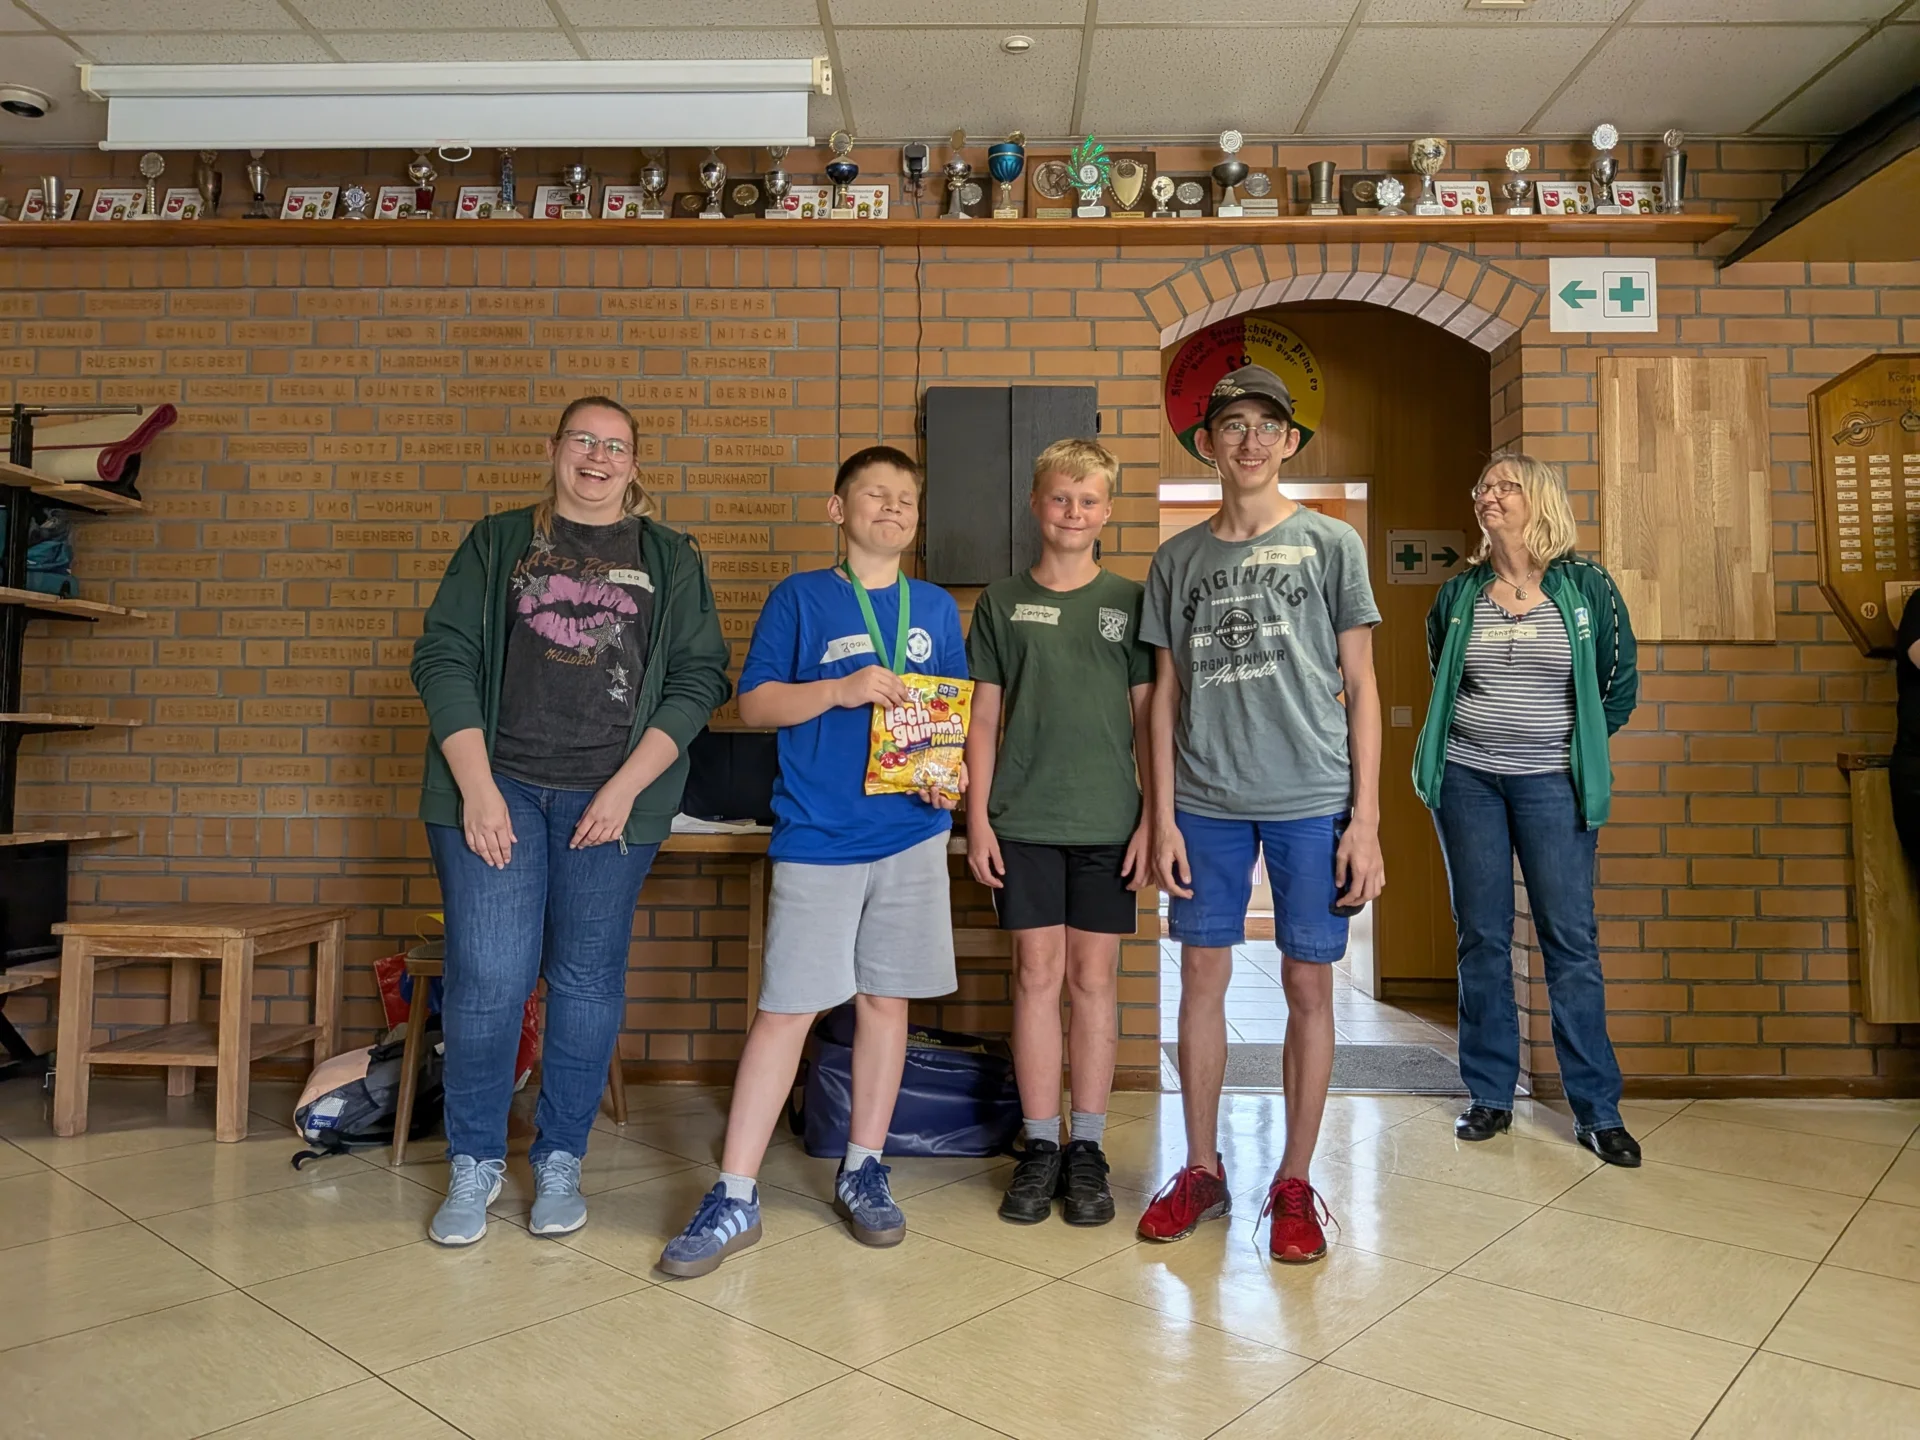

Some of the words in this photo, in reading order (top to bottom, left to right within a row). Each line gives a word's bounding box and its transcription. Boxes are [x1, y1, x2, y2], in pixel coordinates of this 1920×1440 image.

[1081, 187, 1102, 201] 2004
[716, 327, 787, 340] NITSCH
[449, 385, 528, 399] SCHIFFNER
[539, 385, 567, 398] EVA
[628, 383, 699, 399] JÜRGEN
[384, 413, 455, 426] K.PETERS
[715, 444, 785, 457] BARTHOLD
[350, 471, 406, 484] WIESE
[715, 503, 787, 516] D.PALANDT
[336, 529, 414, 543] BIELENBERG
[1264, 550, 1288, 562] Tom
[711, 561, 791, 573] PREISSLER
[1182, 566, 1309, 624] ORIGINALS
[1861, 603, 1876, 620] 19
[316, 618, 386, 631] BRANDES
[1262, 624, 1290, 637] MRK
[1200, 661, 1277, 690] Authentic
[931, 730, 967, 747] minis
